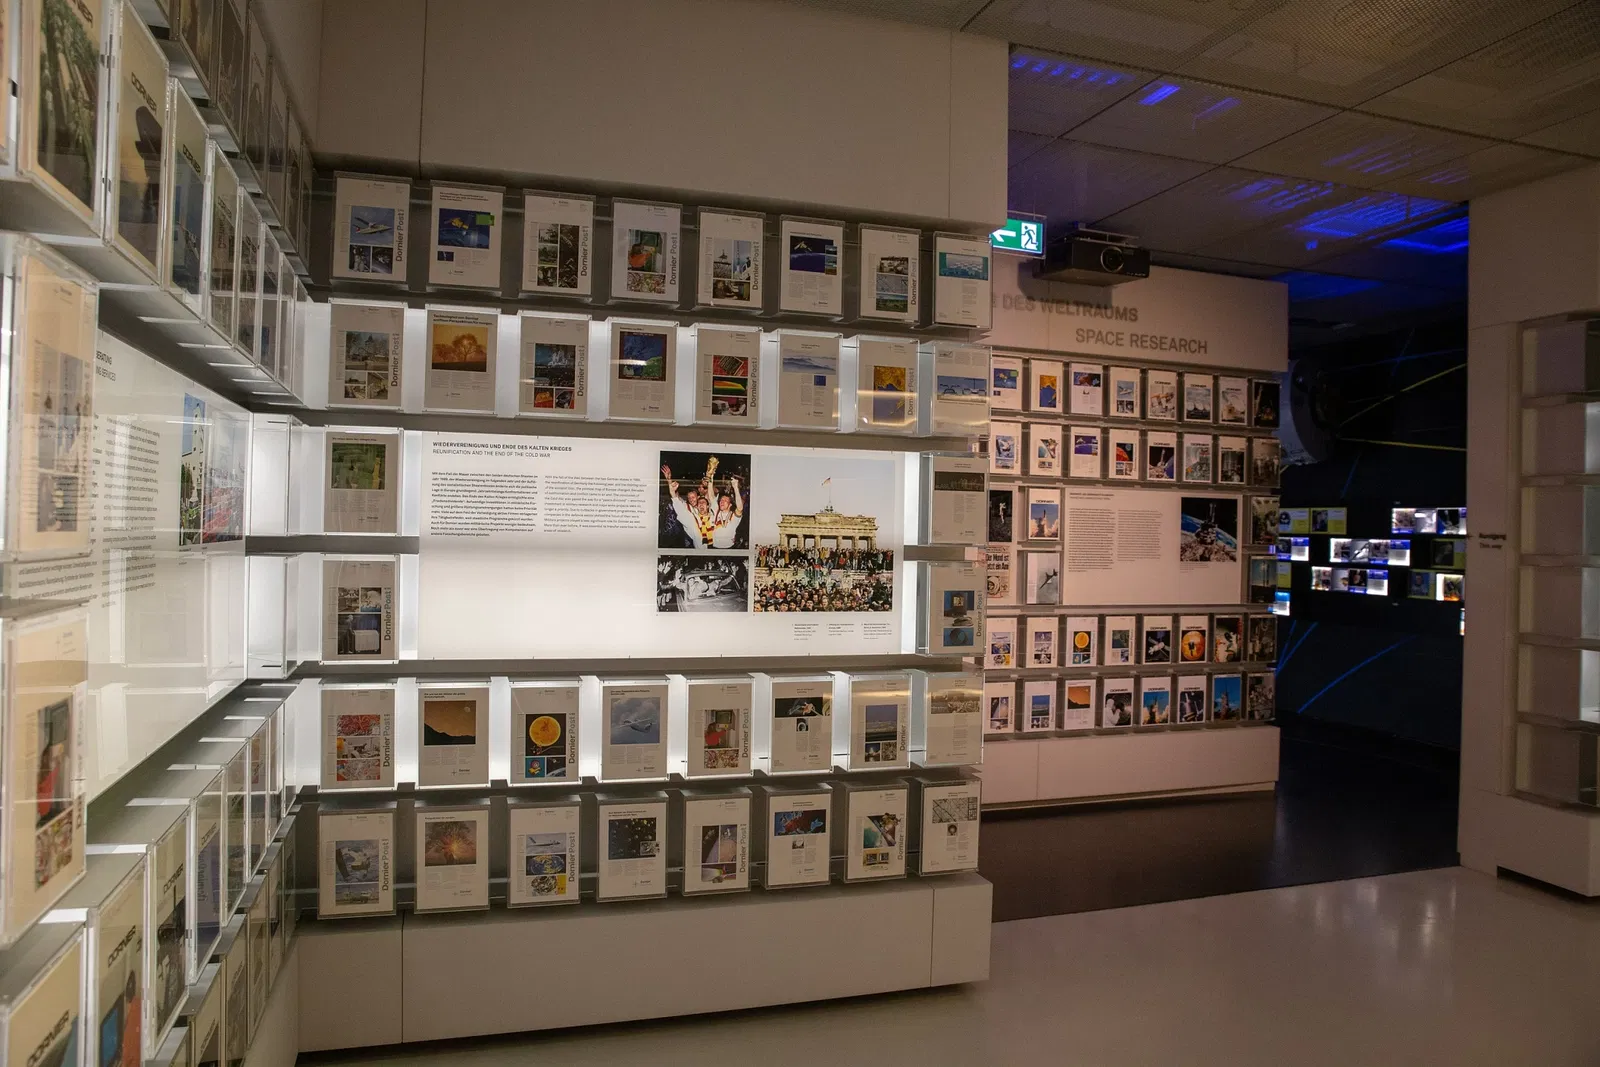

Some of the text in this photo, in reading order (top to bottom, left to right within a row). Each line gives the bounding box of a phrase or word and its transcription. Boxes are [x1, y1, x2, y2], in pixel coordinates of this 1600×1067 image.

[131, 72, 157, 113] DORNIER
[182, 144, 201, 174] DORNIER
[396, 233, 404, 261] Dornier
[1002, 294, 1035, 311] DES
[1041, 296, 1139, 322] WELTRAUMS
[1076, 328, 1208, 354] SPACE RESEARCH
[164, 863, 184, 894] DORNIER
[108, 925, 136, 968] DORNIER
